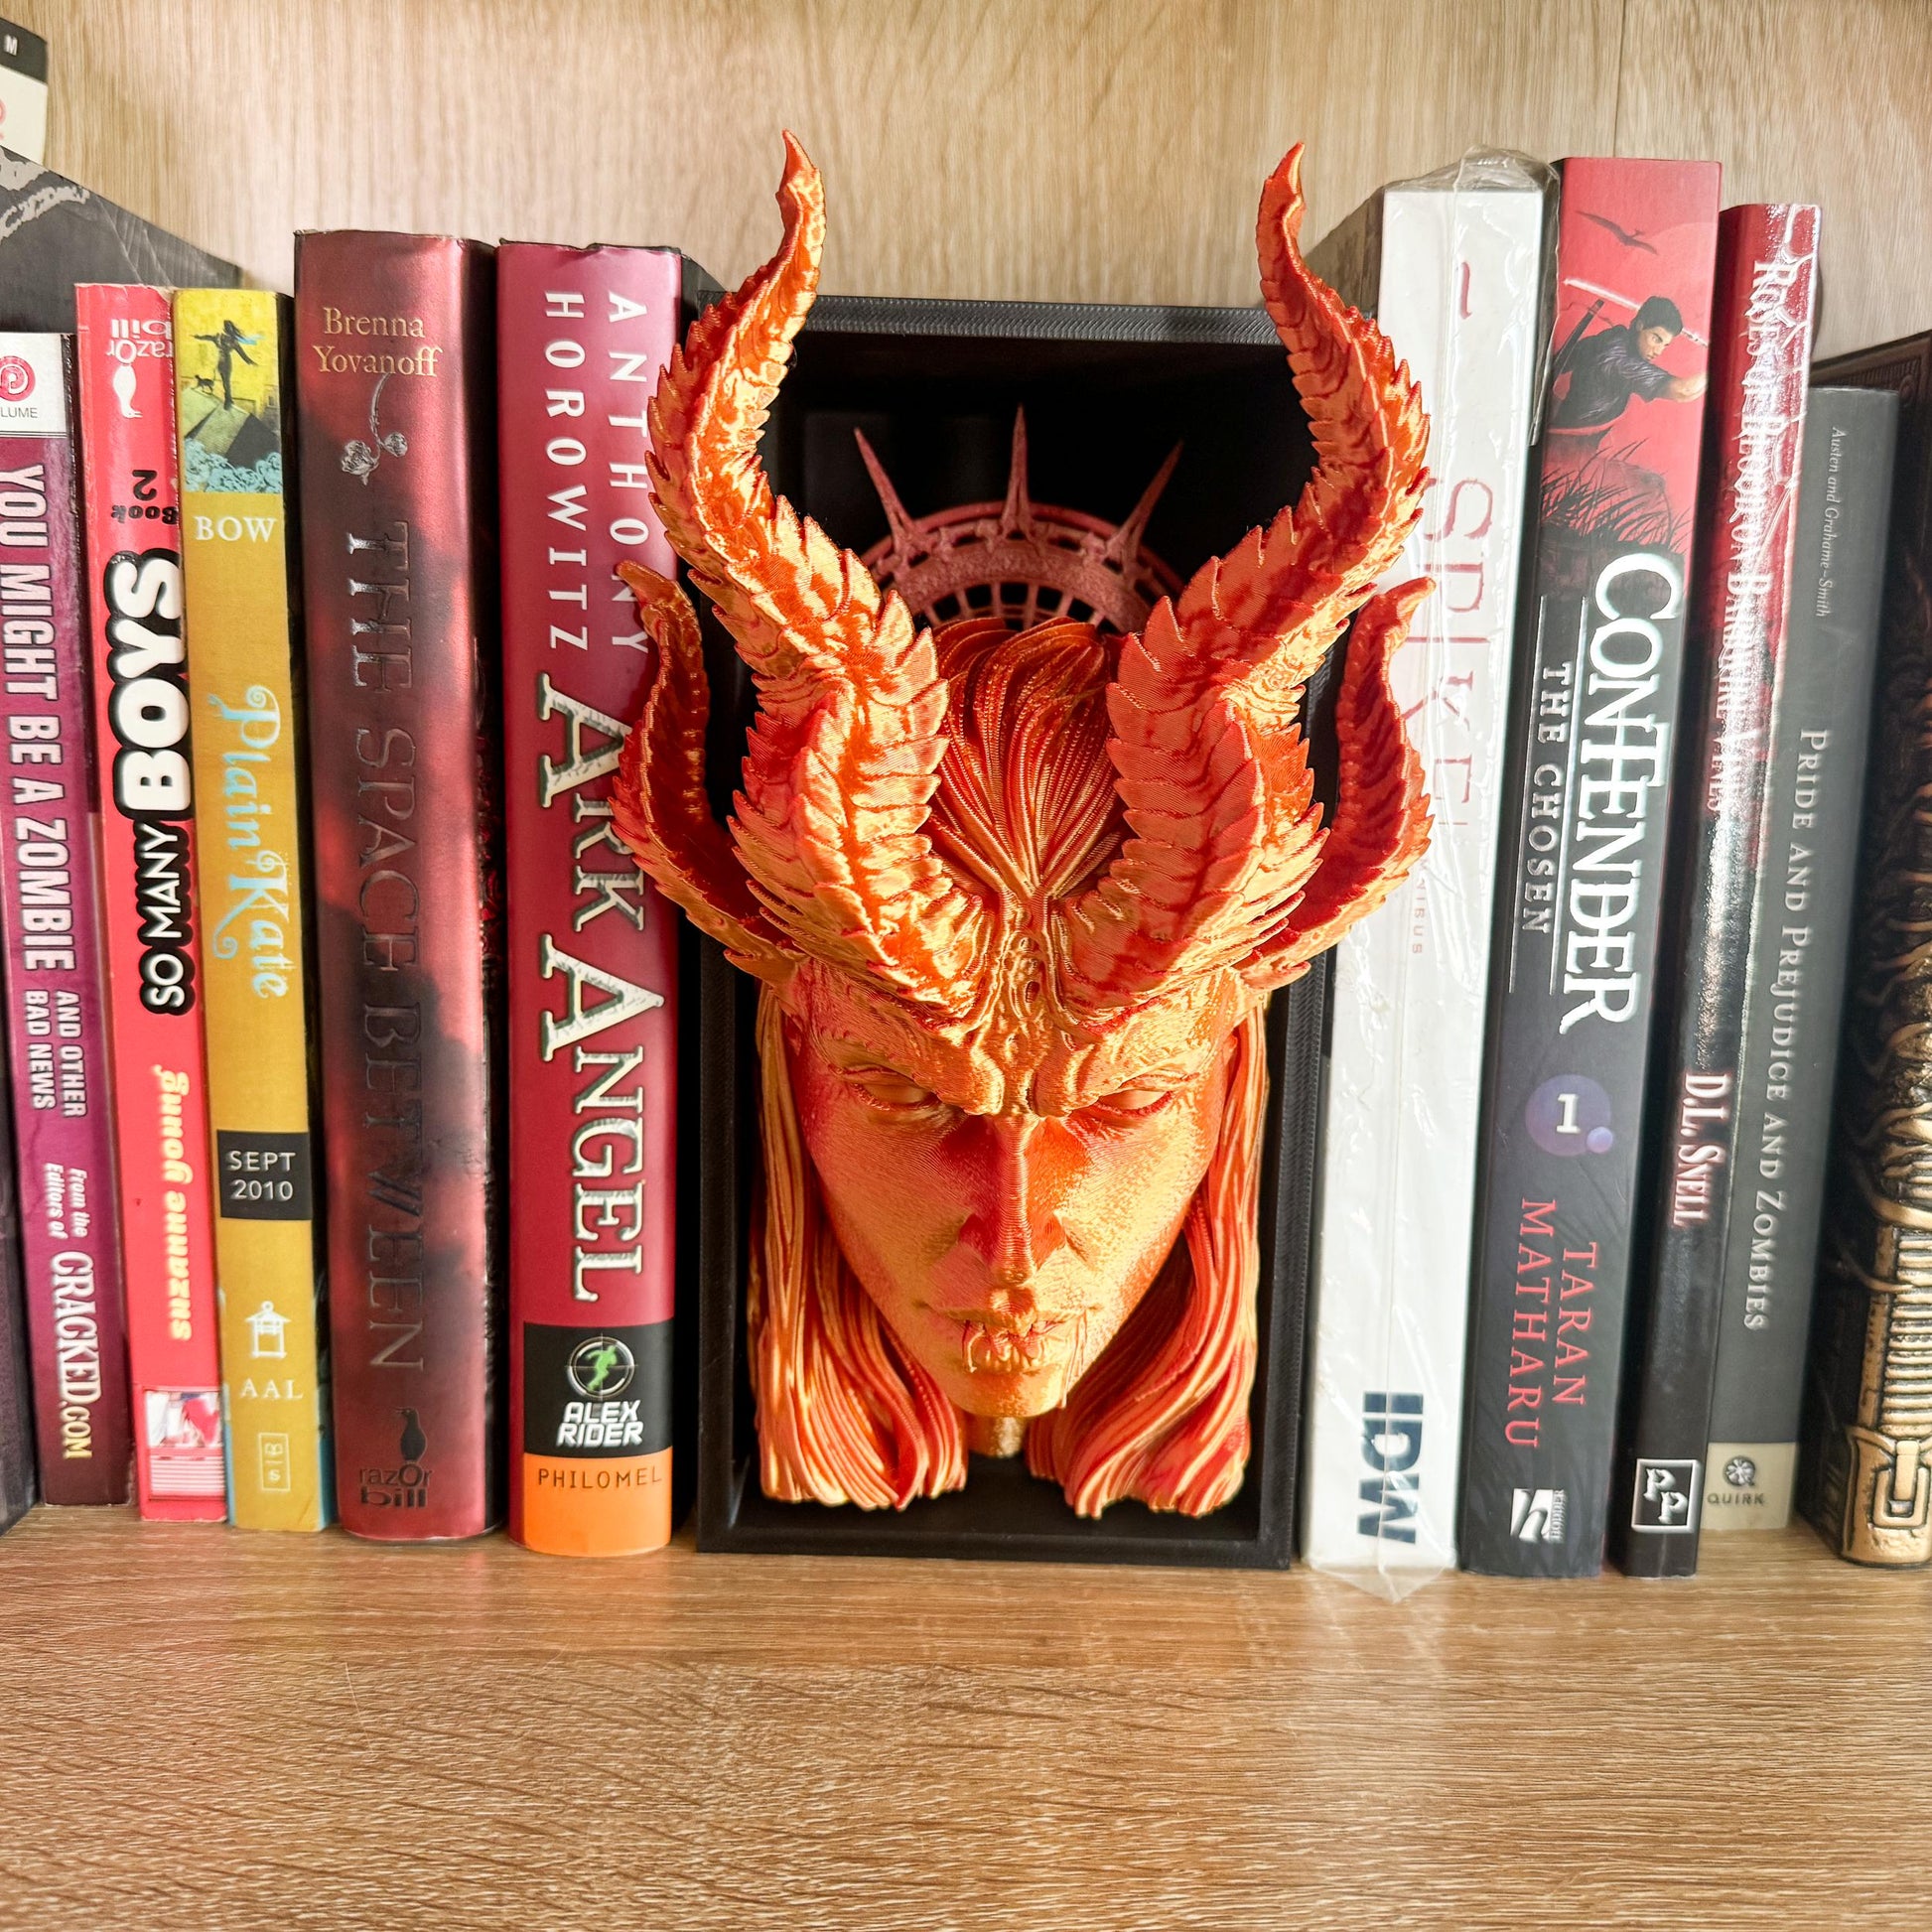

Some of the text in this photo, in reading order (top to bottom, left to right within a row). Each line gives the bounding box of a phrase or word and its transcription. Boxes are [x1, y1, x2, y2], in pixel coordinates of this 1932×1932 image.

[111, 319, 173, 339] bill
[313, 345, 444, 377] Yovanoff
[324, 308, 426, 339] Brenna
[0, 406, 38, 420] LUME
[543, 291, 590, 651] HOROWITZ
[111, 504, 179, 525] Book
[131, 470, 158, 502] 2
[195, 516, 276, 543] BOW
[1815, 425, 1849, 619] Austen and Grahame-Smith
[0, 463, 76, 971] YOU MIGHT BE A ZOMBIE
[113, 556, 191, 1008] SO MANY BOYS
[207, 685, 297, 1000] Plain Katie
[1519, 661, 1575, 935] THE CHOSEN
[1557, 552, 1685, 1035] CONTENDER
[345, 520, 425, 1372] THE SPACE BETWEEN
[537, 672, 665, 1303] ARK ANGEL
[25, 990, 57, 1111] BAD NEWS
[57, 990, 87, 1118] AND OTHER
[1744, 729, 1830, 1331] PRIDE AND PREJUDICE AND ZOMBIES
[225, 1150, 297, 1173] SEPT
[1554, 1091, 1582, 1134] 1
[1673, 1072, 1729, 1227] D.L. SNELL
[44, 1162, 69, 1240] Editors of
[67, 1168, 90, 1239] From the
[151, 1063, 194, 1341] suzanne young
[233, 1179, 295, 1200] 2010
[51, 1251, 102, 1460] CRACKED.COM
[1504, 1196, 1557, 1449] MATHARU
[1551, 1241, 1597, 1406] TARAN
[556, 1422, 644, 1449] RIDER
[562, 1399, 641, 1424] ALEX
[1356, 1391, 1424, 1545] IDW
[359, 1487, 428, 1508] bill
[537, 1464, 663, 1490] PHILOMEL
[1707, 1493, 1766, 1507] QUIRK
